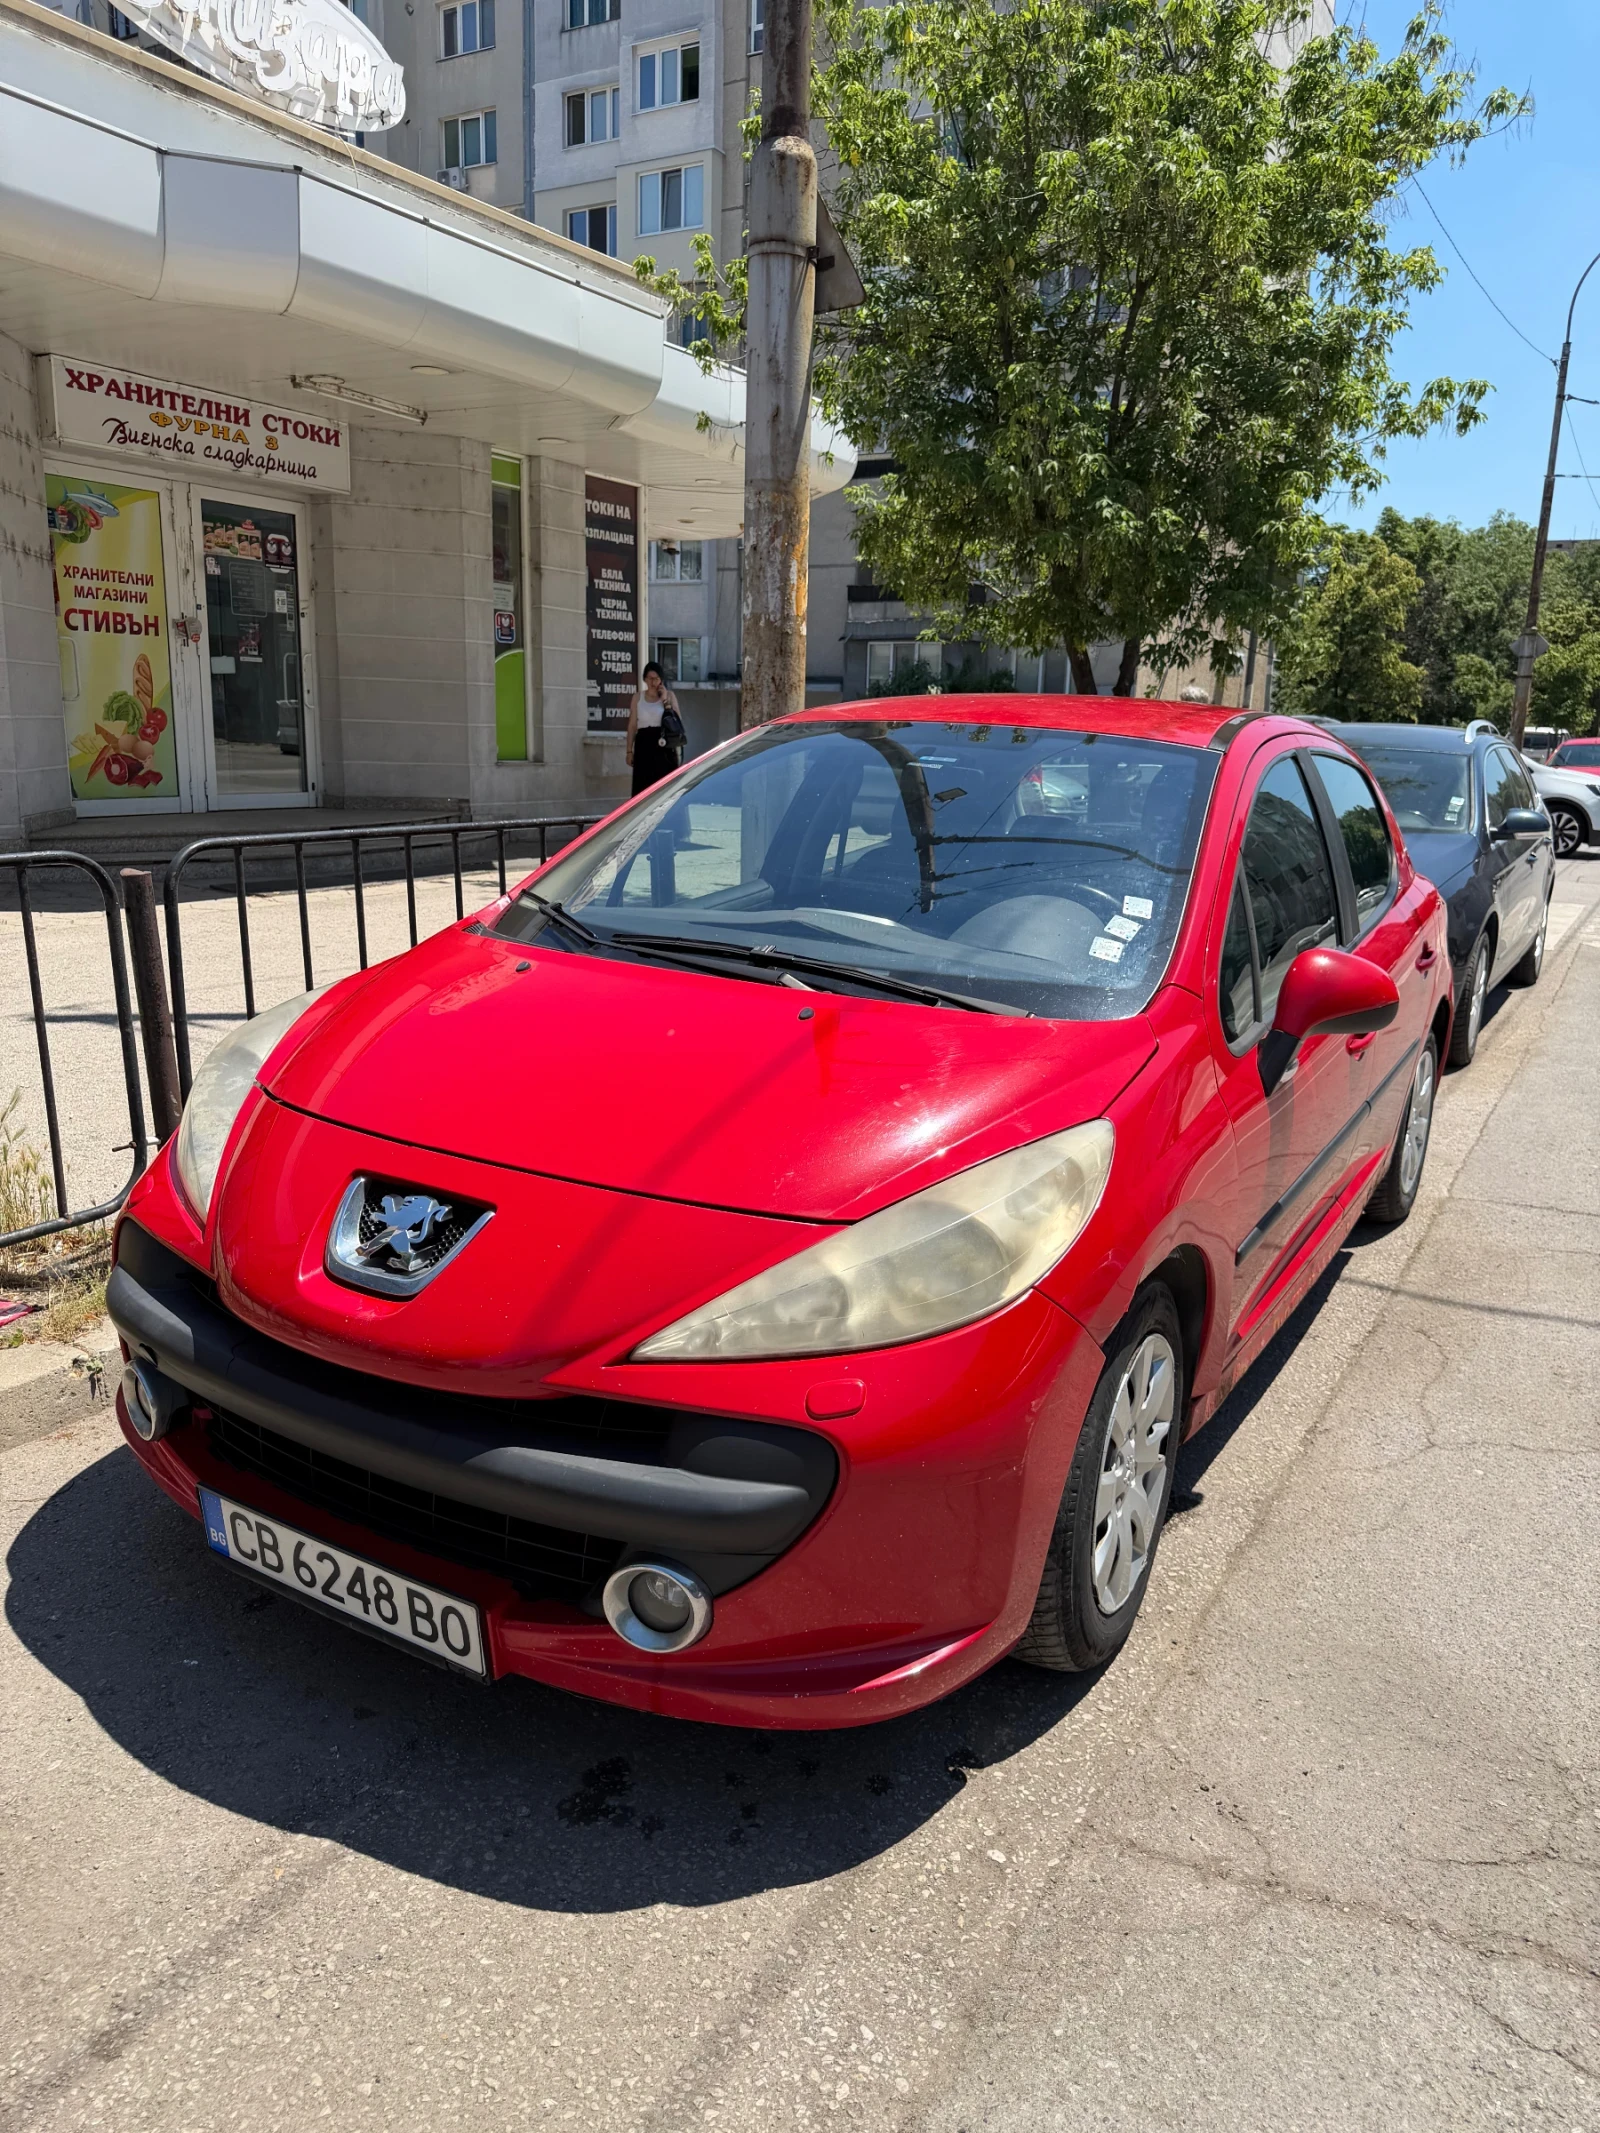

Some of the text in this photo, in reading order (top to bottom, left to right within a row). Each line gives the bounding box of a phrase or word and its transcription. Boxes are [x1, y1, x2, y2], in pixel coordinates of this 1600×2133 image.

[65, 368, 341, 447] ХРАНИТЕЛНИ СТОКИ
[149, 411, 249, 445] ФУРНА
[101, 417, 318, 479] Виенска сладкарница
[585, 499, 631, 520] ТОКИ НА
[63, 565, 154, 587] ХРАНИТЕЛНИ
[601, 568, 623, 581] БЯЛА
[74, 585, 148, 604] МАГАЗИНИ
[594, 579, 631, 593] ТЕХНИКА
[601, 598, 628, 610] ЧЕРНА
[64, 608, 159, 636] СТИВЪН
[596, 608, 633, 622] ТЕХНИКА
[591, 629, 636, 642] ТЕЛЕФОНИ
[602, 650, 632, 662] СТЕРЕО
[601, 662, 633, 674] УРЕДБИ
[604, 683, 637, 694] МЕБЕЛИ
[210, 1527, 227, 1547] BG
[293, 1541, 398, 1625] 6248
